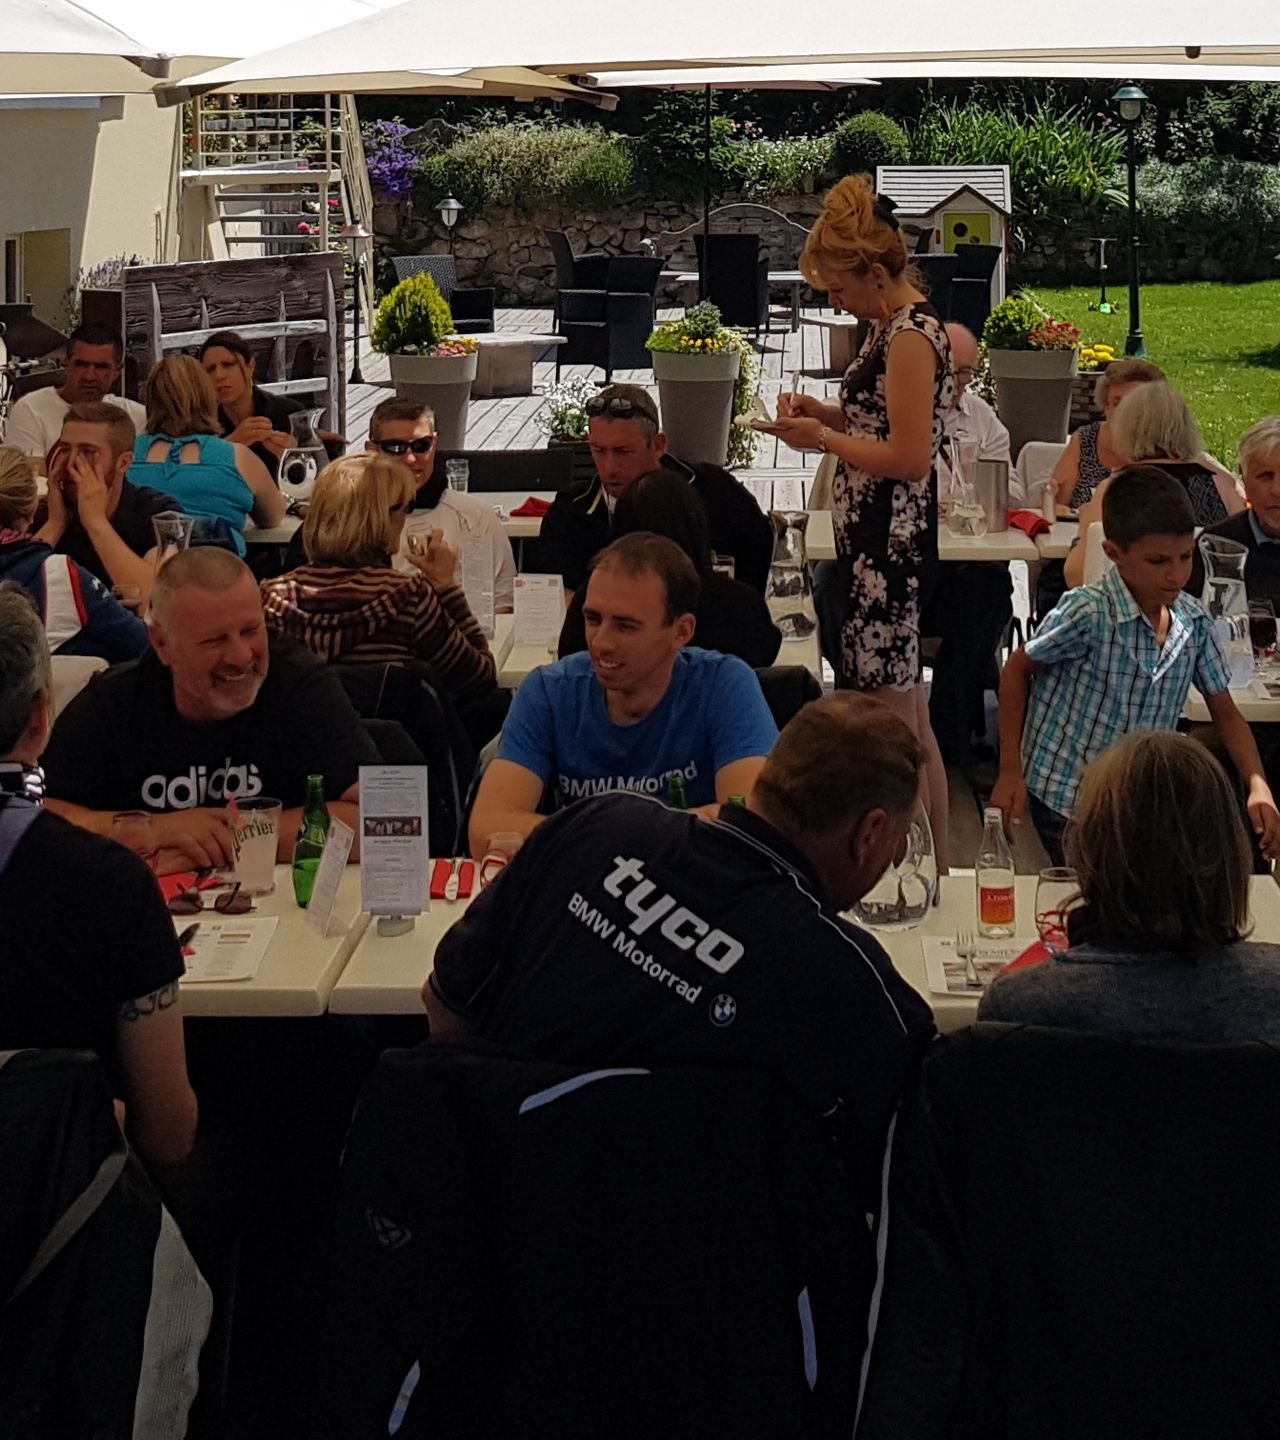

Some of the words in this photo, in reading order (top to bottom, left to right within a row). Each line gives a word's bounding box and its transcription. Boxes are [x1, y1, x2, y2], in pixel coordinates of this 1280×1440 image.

[141, 756, 263, 809] adidas
[558, 773, 613, 800] BMW
[567, 892, 617, 940] BMW
[612, 930, 703, 1005] Motorrad
[603, 854, 745, 974] tyco
